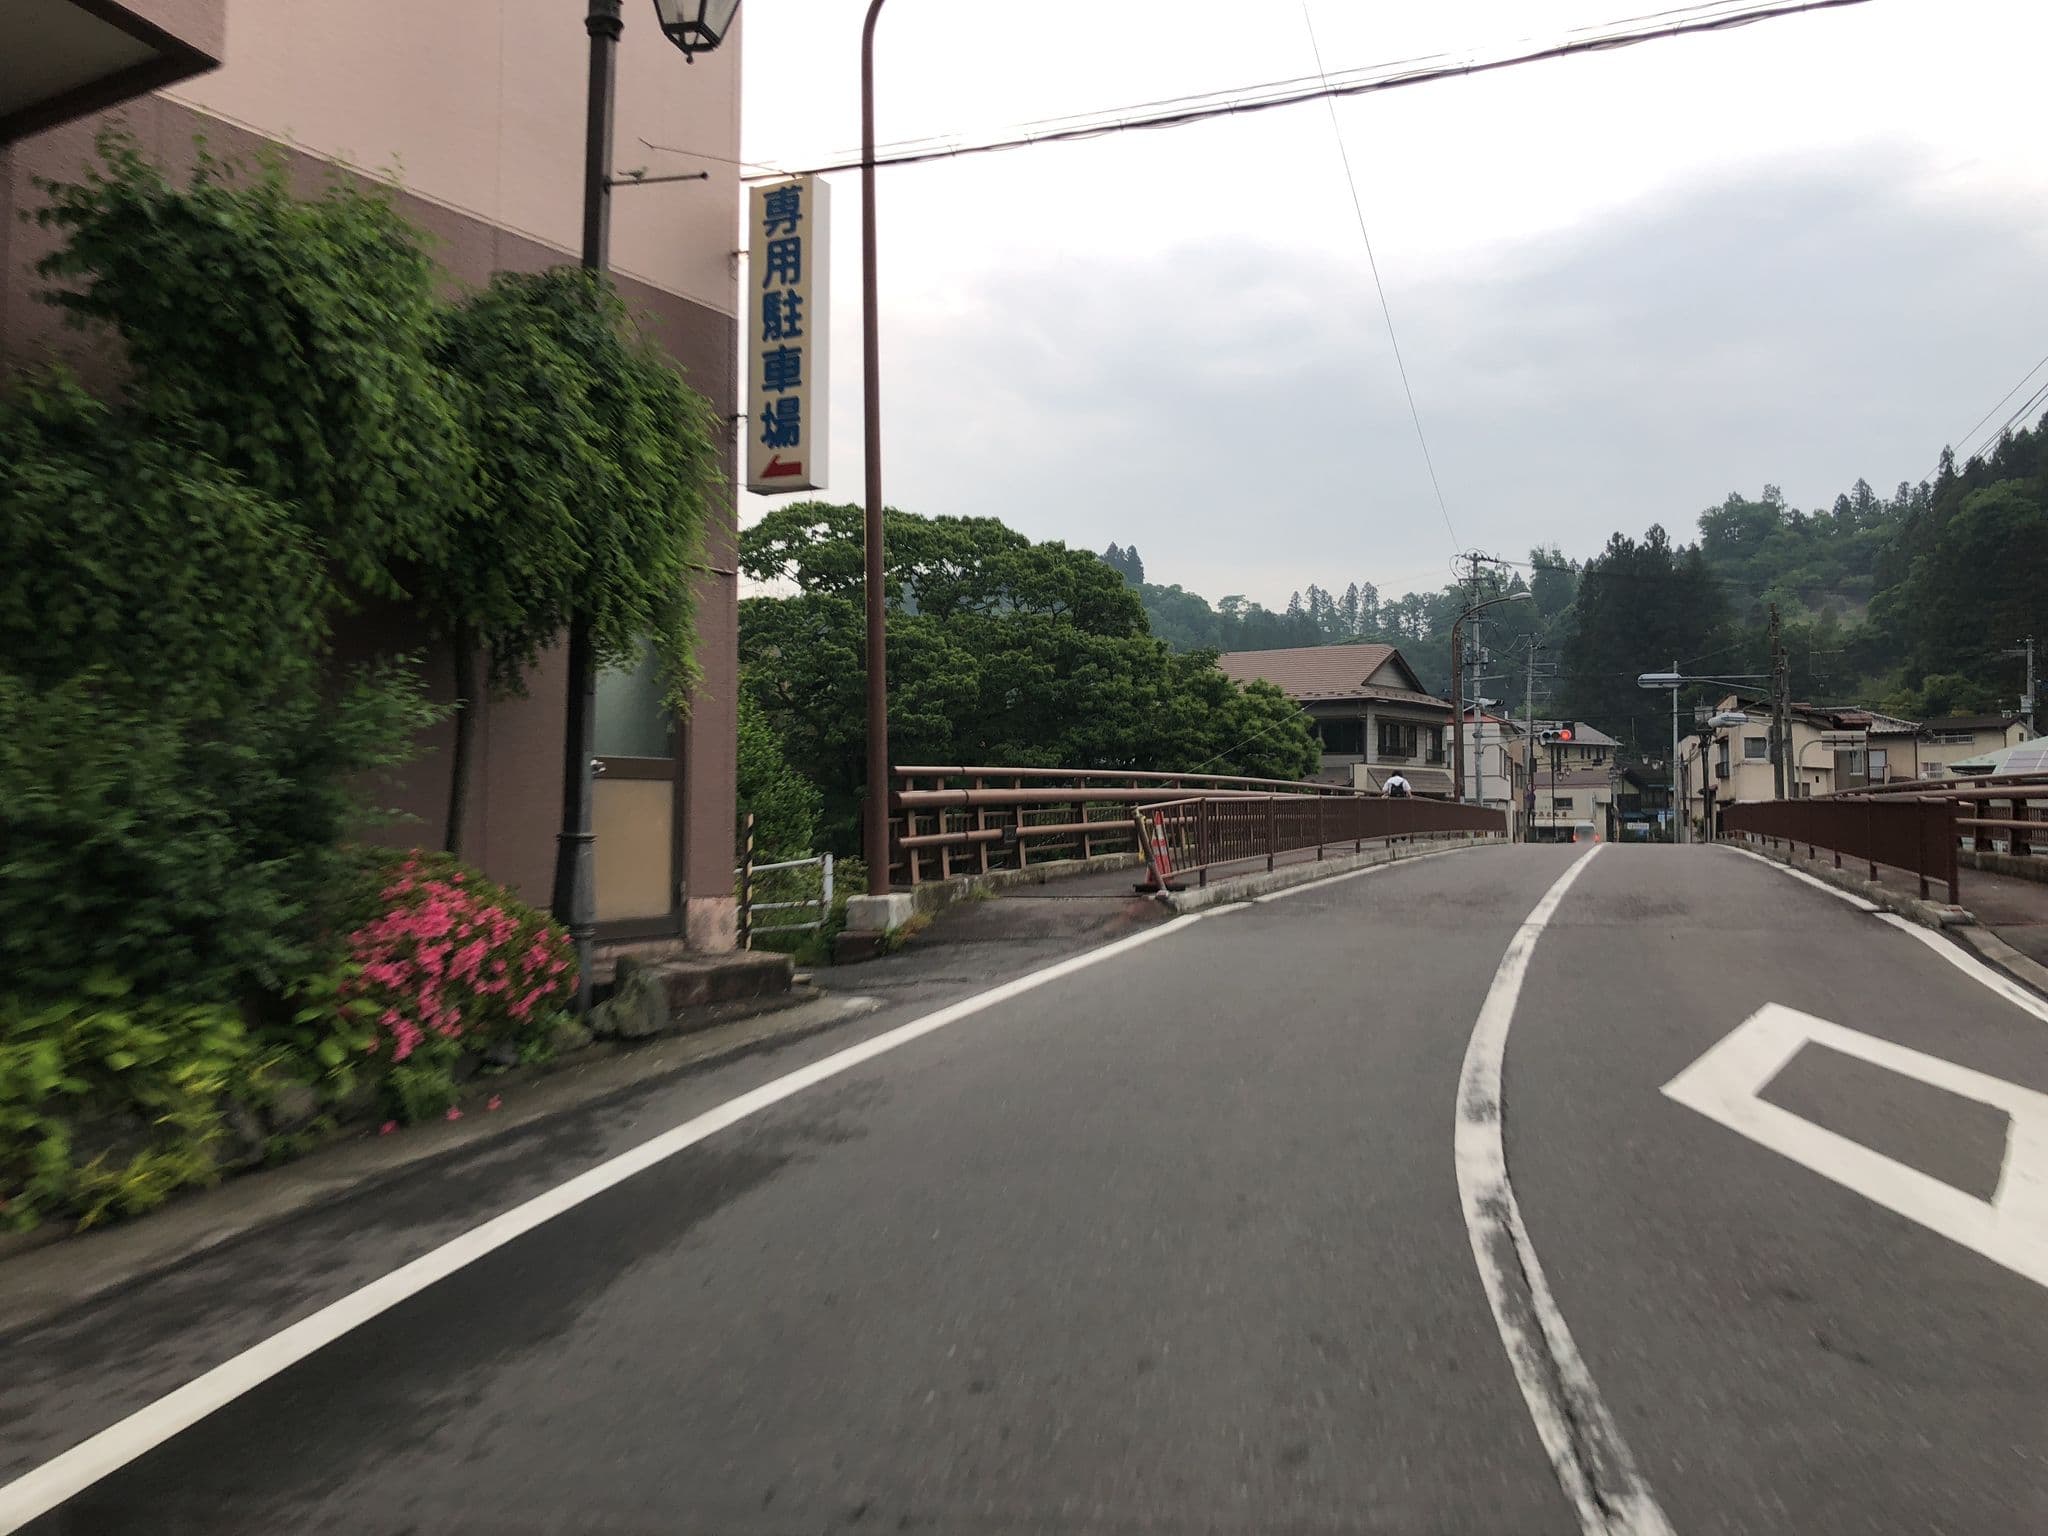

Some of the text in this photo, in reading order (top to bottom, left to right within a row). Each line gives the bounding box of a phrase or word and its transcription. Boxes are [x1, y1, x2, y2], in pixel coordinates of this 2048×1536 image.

[761, 185, 803, 449] 専用駐車場
